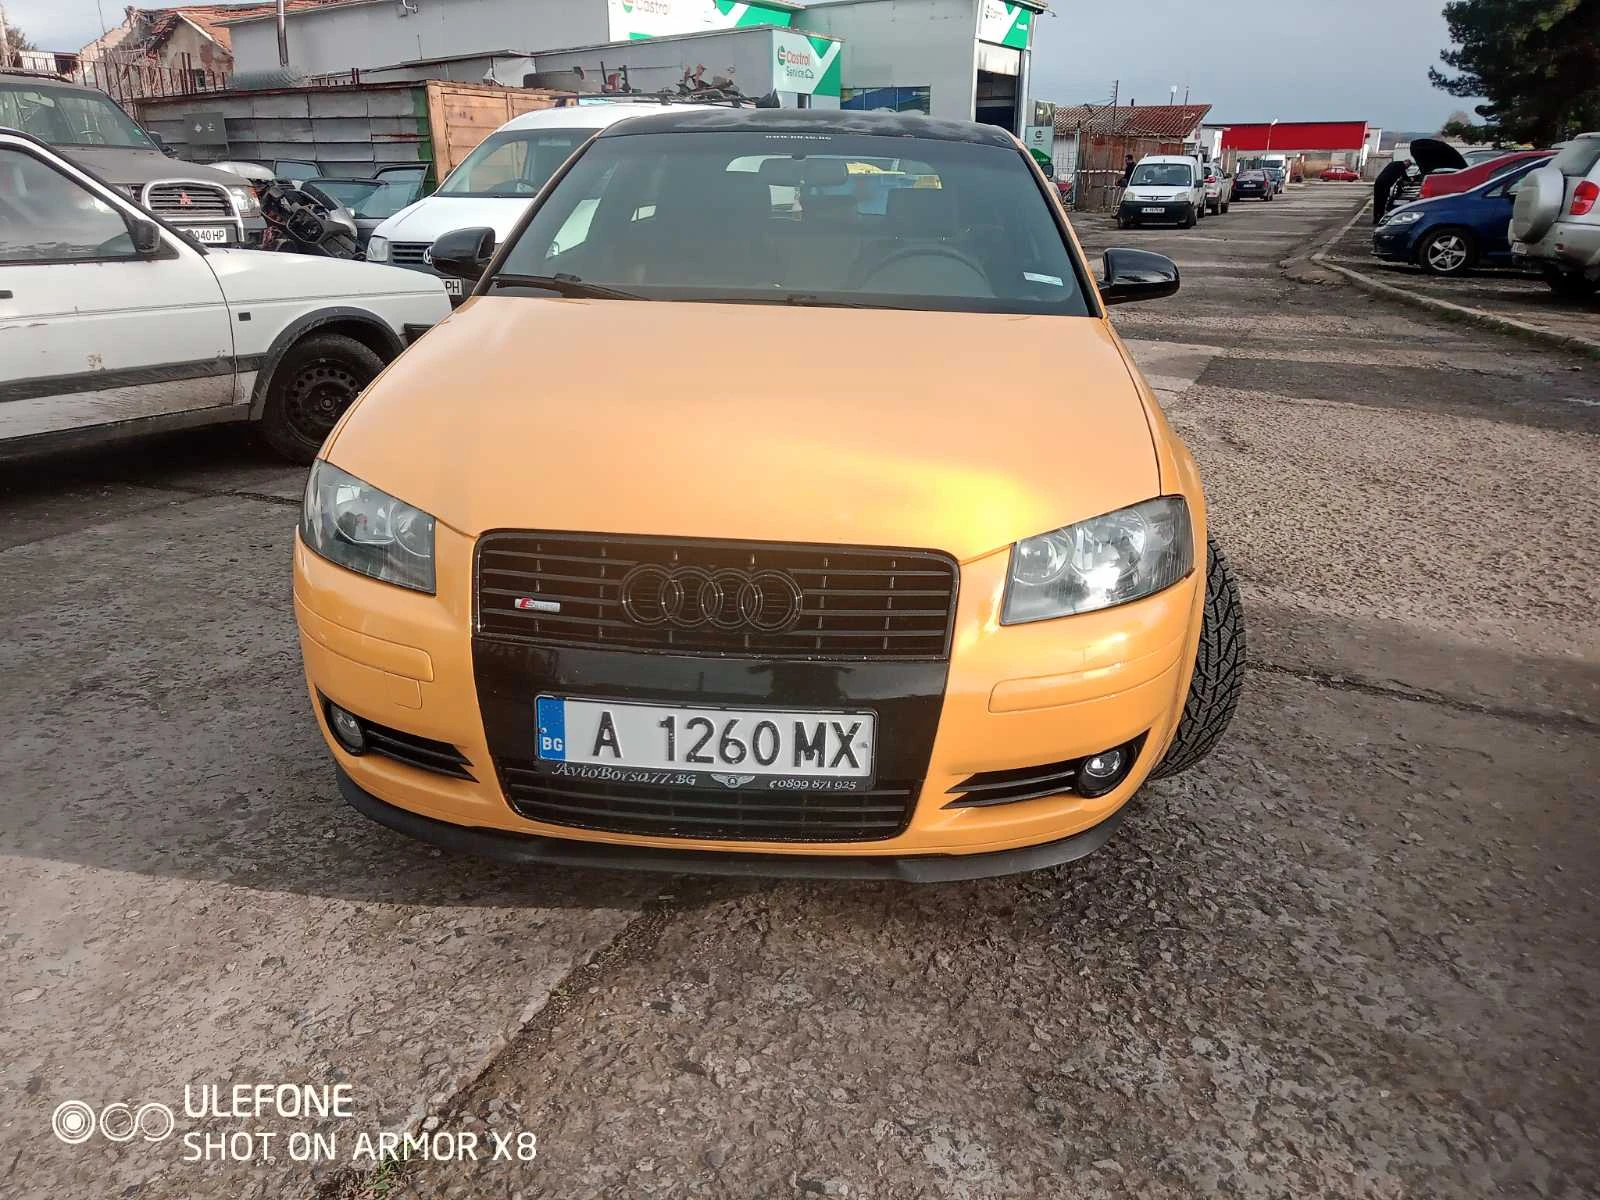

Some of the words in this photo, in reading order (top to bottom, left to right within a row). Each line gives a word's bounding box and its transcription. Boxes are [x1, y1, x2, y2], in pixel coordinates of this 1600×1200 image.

[786, 51, 811, 66] Castrol
[445, 280, 460, 294] PH
[542, 737, 563, 751] BG
[592, 711, 622, 758] A
[659, 715, 781, 767] 1260
[794, 721, 863, 769] MX
[778, 779, 809, 790] 0899
[812, 780, 831, 790] 871
[834, 781, 857, 790] 925
